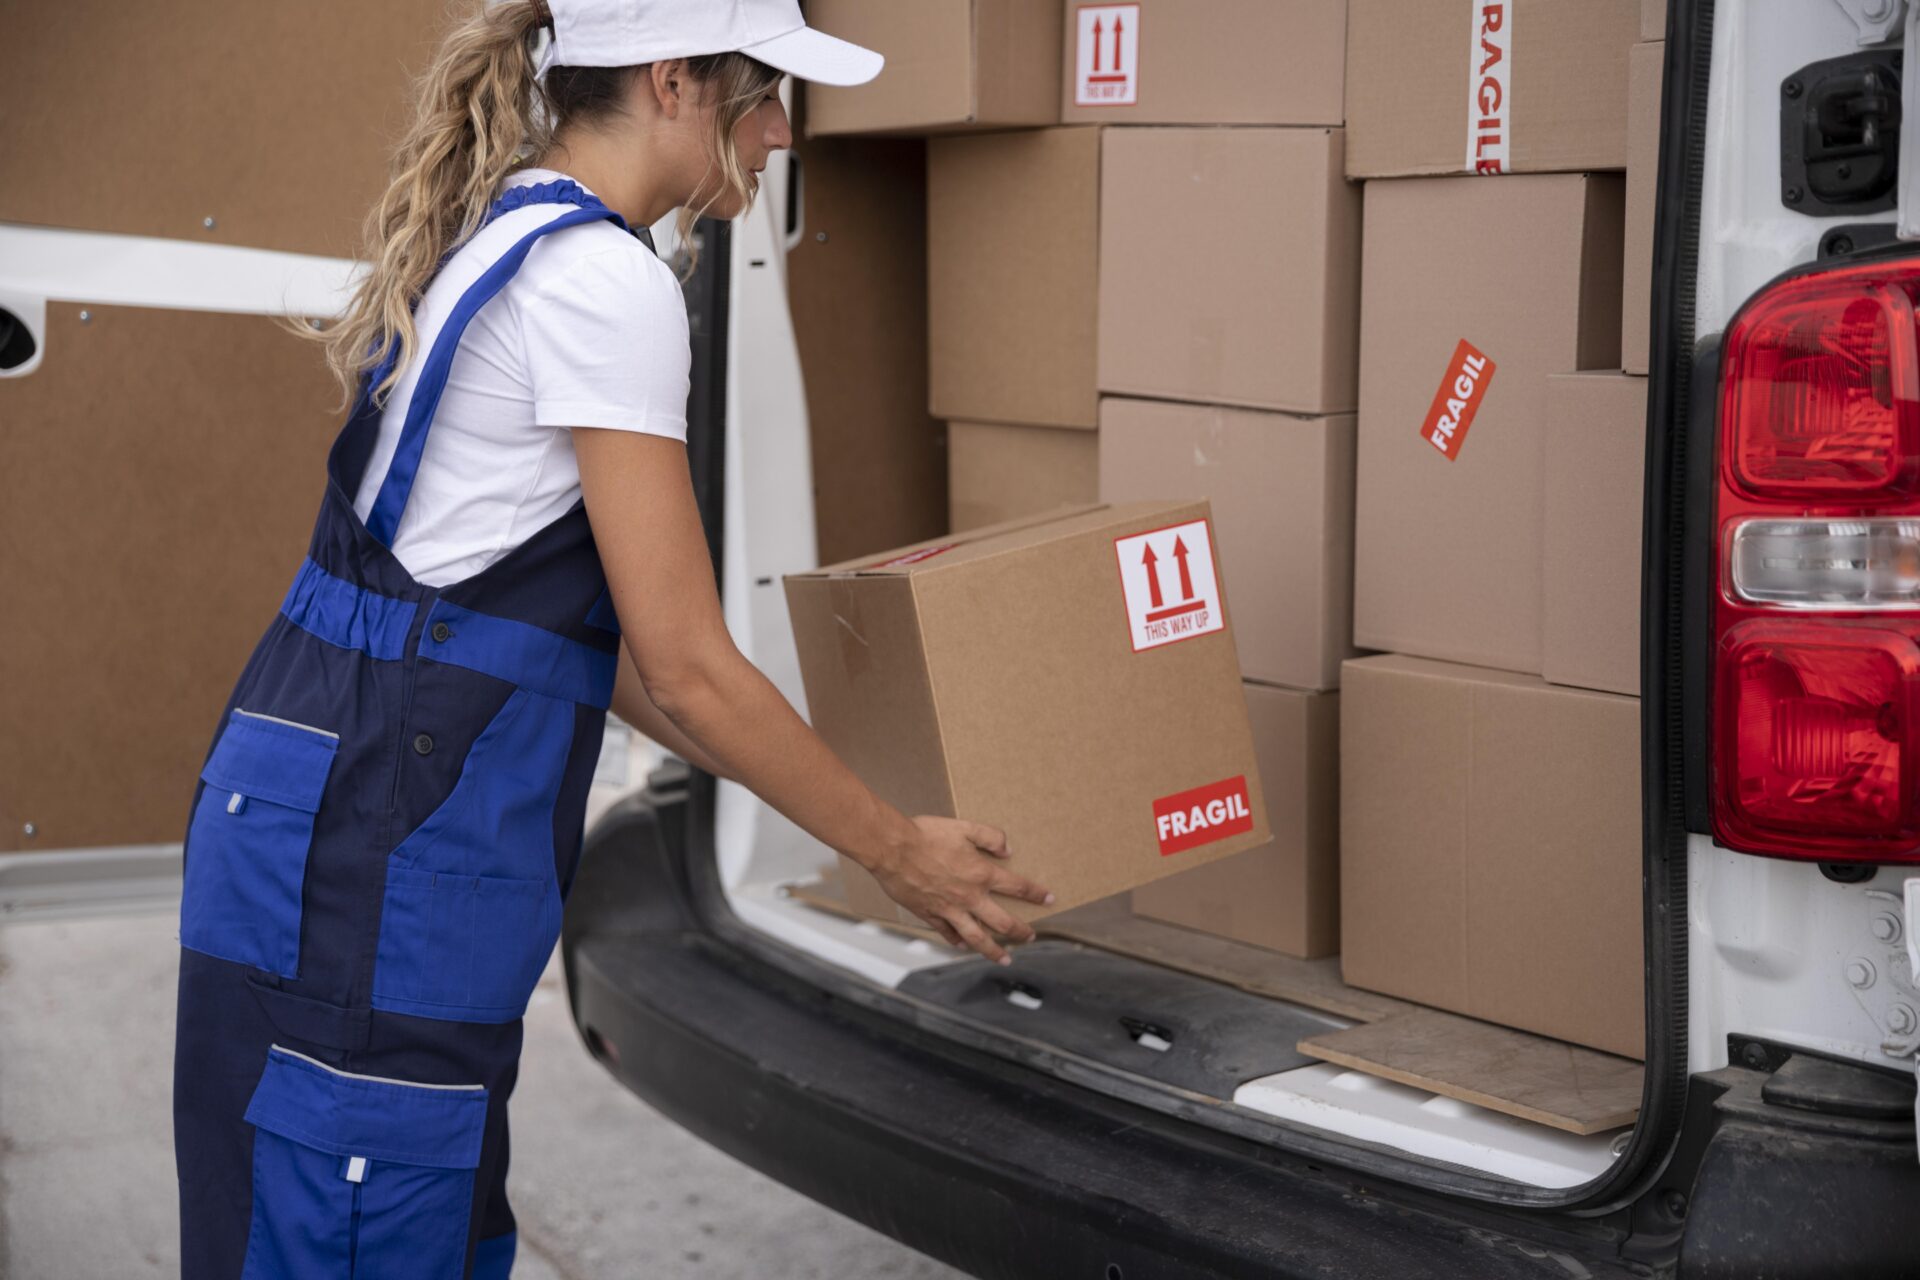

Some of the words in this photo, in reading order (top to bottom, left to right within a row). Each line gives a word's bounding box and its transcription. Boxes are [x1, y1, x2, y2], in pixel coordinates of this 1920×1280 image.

[1430, 353, 1486, 452] FRAGIL
[1144, 621, 1168, 641] THIS
[1170, 615, 1193, 634] WAY
[1194, 610, 1209, 629] UP
[1157, 793, 1249, 841] FRAGIL
